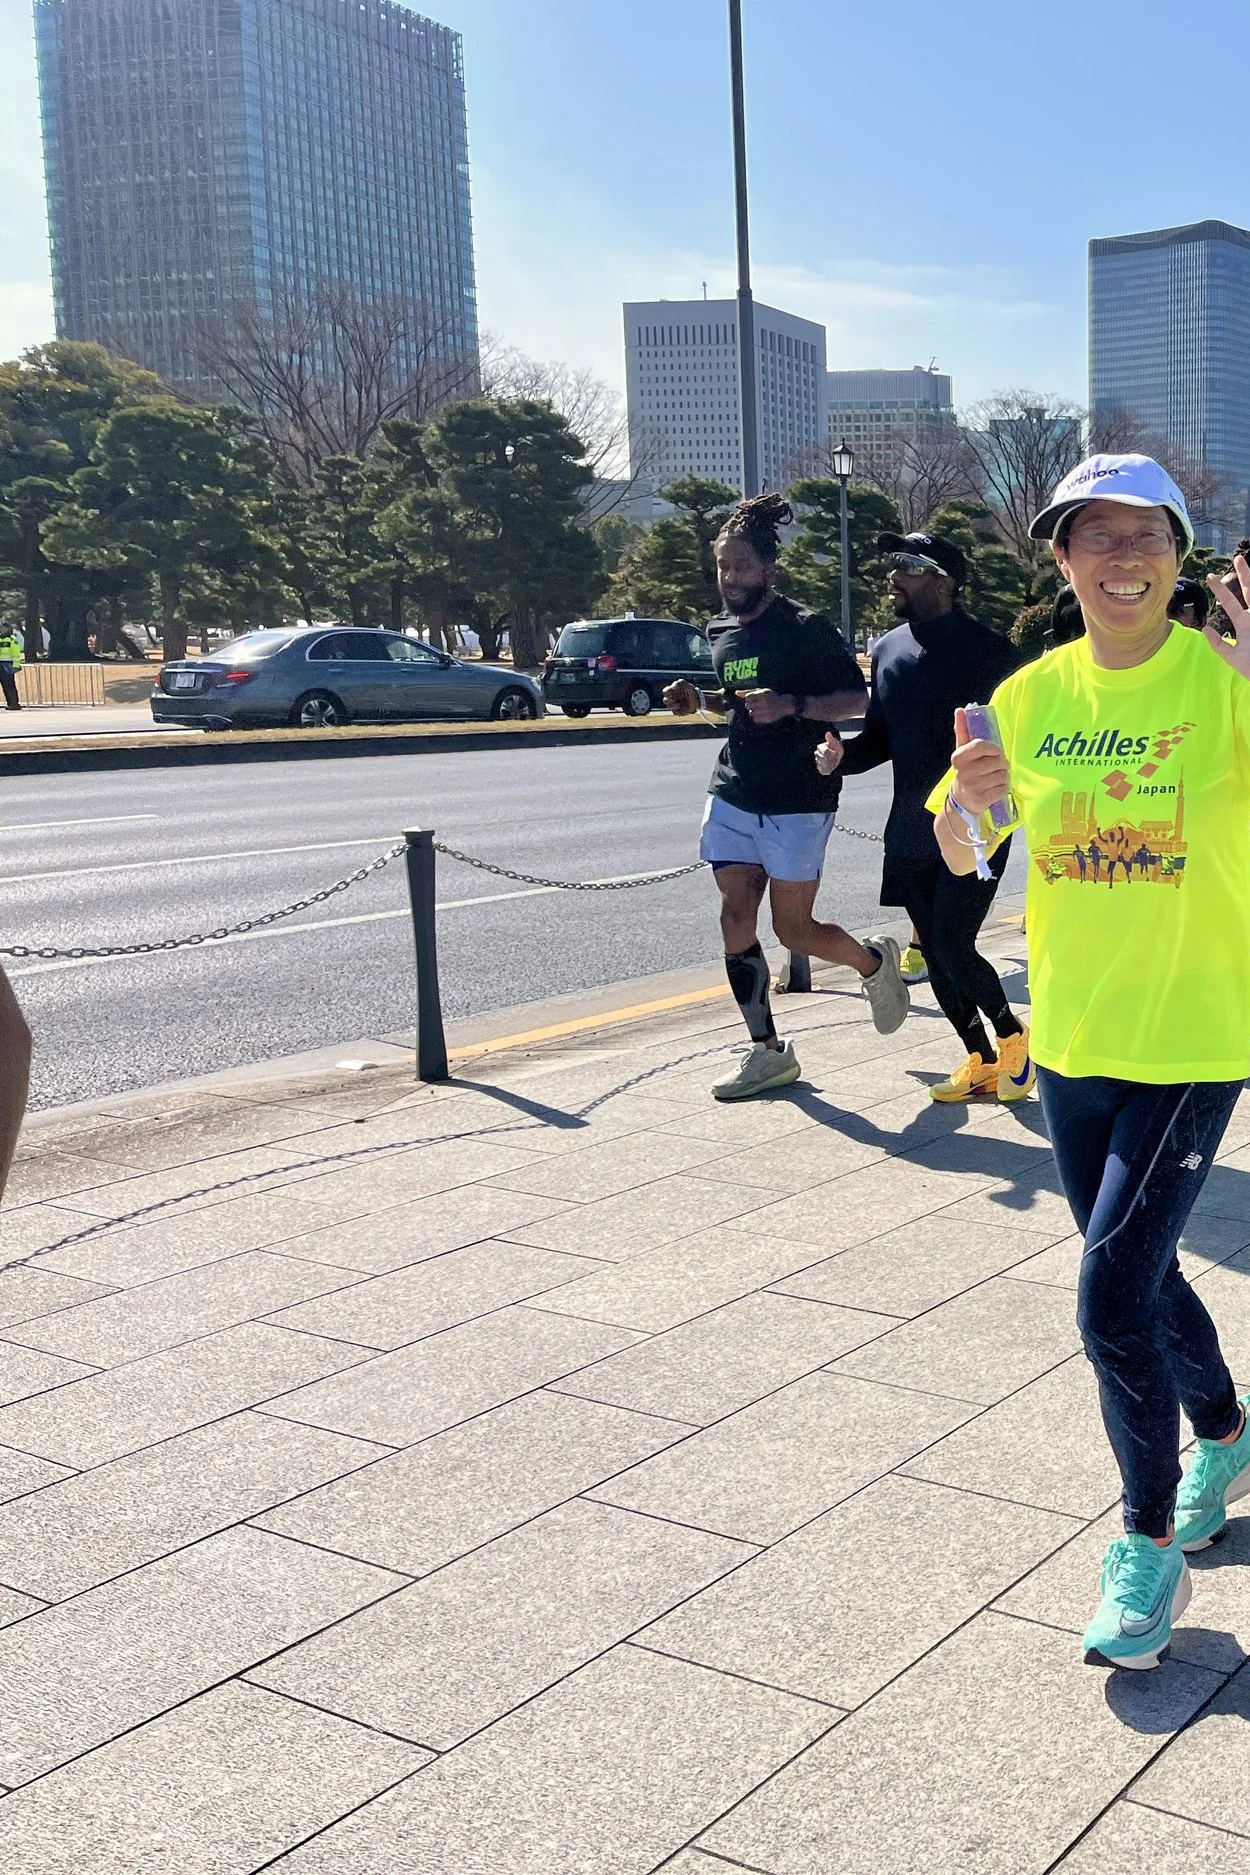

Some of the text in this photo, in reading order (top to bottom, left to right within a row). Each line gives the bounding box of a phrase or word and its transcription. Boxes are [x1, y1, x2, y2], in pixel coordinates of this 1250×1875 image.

[1034, 729, 1150, 759] Achilles
[1055, 757, 1142, 767] INTERNATIONAL
[1137, 784, 1176, 797] Japan
